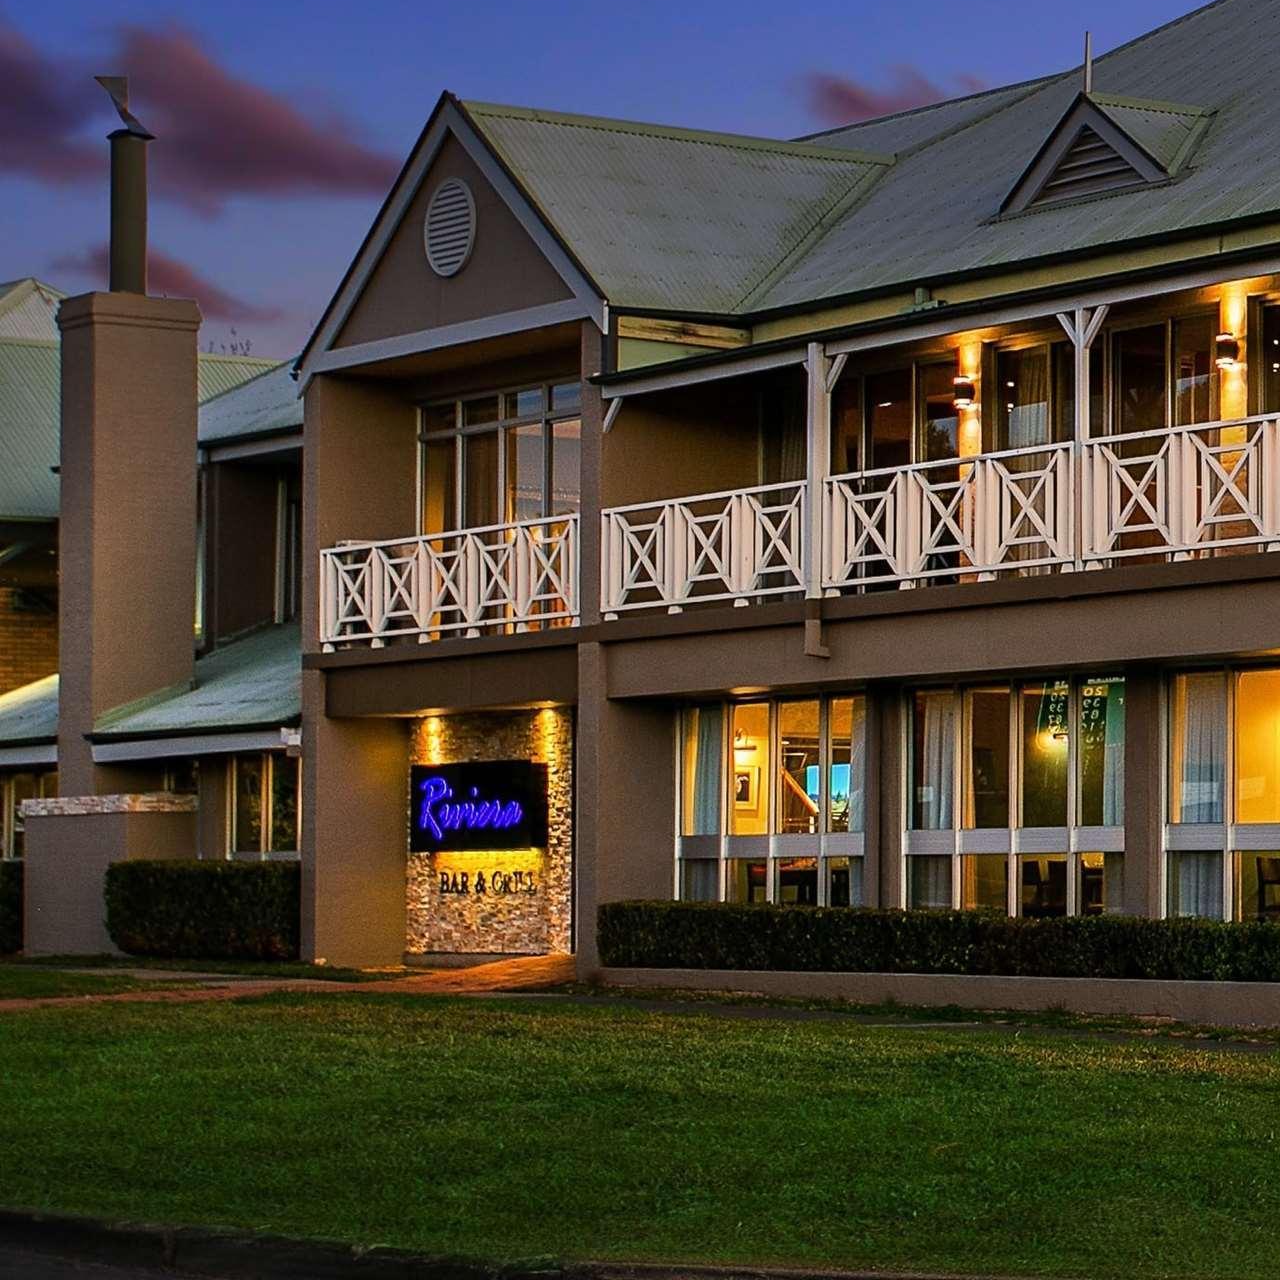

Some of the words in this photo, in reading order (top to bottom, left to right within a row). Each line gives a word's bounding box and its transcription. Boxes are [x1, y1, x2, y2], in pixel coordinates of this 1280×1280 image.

[439, 871, 468, 894] BAR
[474, 872, 486, 894] &
[492, 872, 538, 894] GRILL
